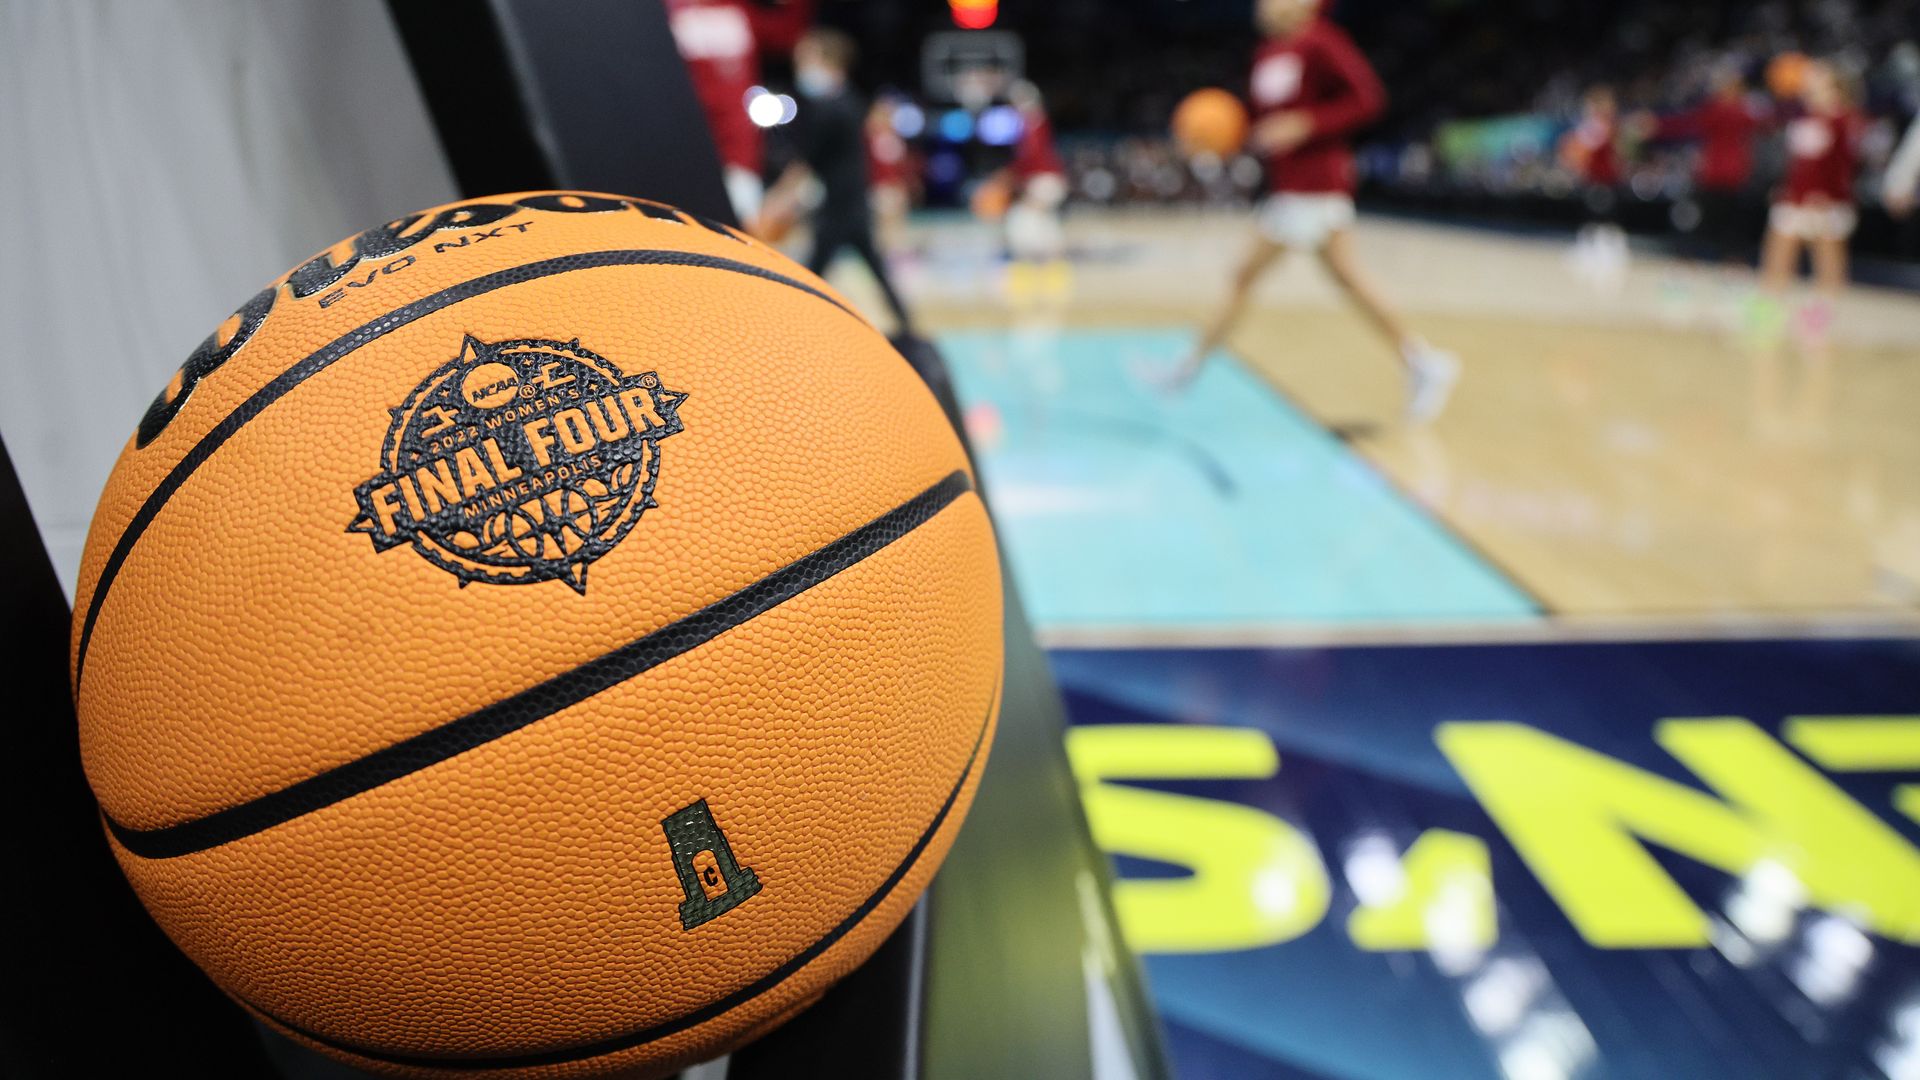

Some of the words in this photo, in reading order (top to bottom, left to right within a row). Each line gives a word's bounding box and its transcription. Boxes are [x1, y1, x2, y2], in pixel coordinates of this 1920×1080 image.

[319, 255, 417, 308] EVO
[433, 221, 534, 254] NXT
[430, 425, 479, 454] 2022
[485, 388, 580, 430] WOMEN'S
[471, 376, 519, 402] NCAA
[370, 437, 523, 537] FINAL
[522, 387, 667, 468] FOUR
[463, 454, 603, 519] MINNEAPOLIS
[703, 866, 718, 887] C
